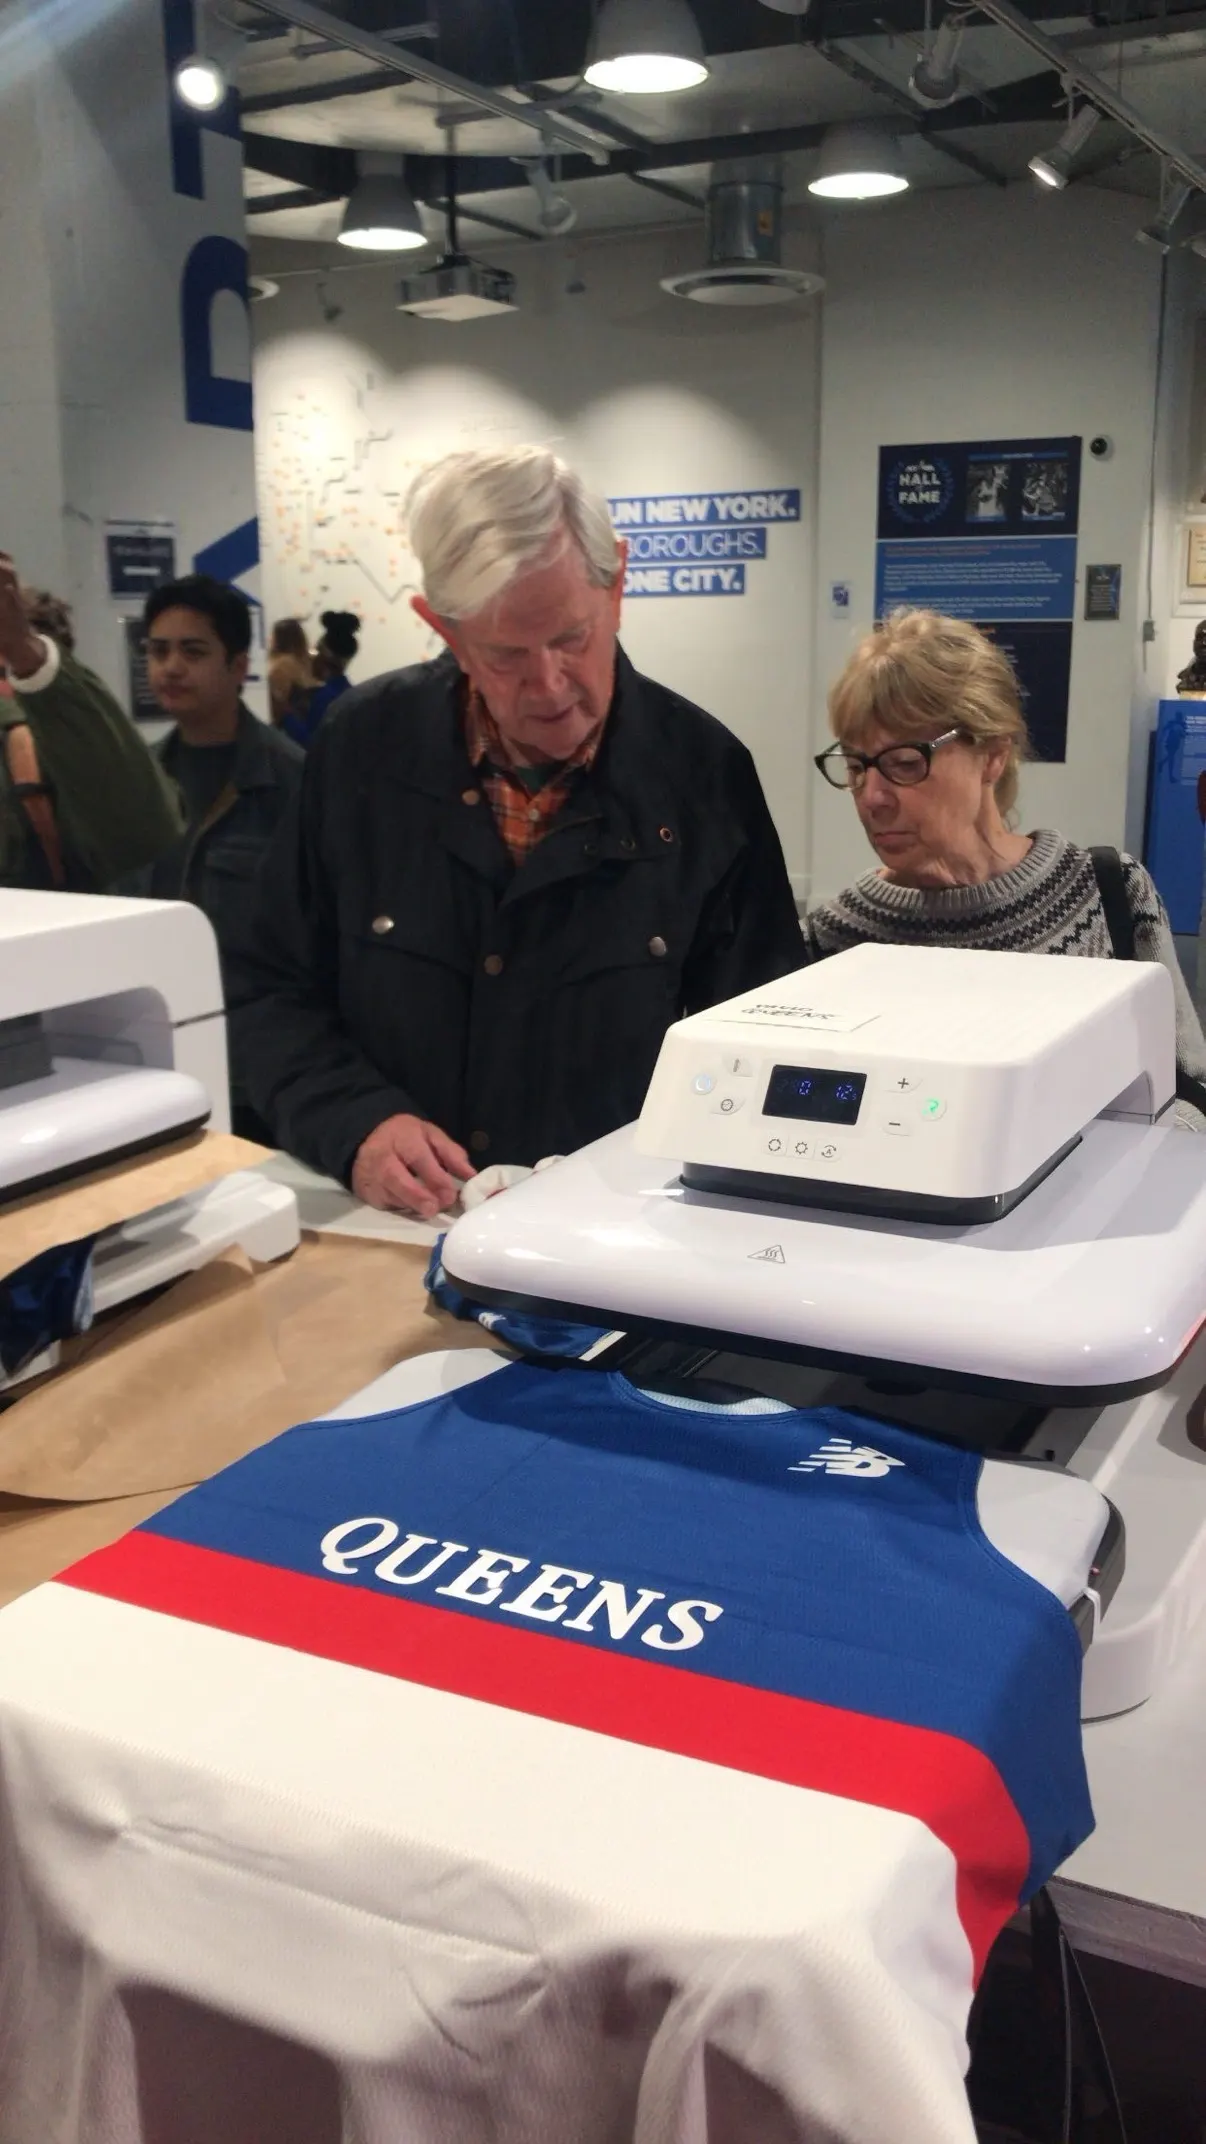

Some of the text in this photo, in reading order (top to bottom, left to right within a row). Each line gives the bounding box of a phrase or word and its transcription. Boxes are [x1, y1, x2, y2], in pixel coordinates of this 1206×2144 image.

[899, 473, 941, 486] HALL
[607, 494, 797, 524] UN NEW YORK.
[899, 491, 940, 504] FAME
[673, 567, 742, 591] CITY.
[320, 1517, 724, 1651] QUEENS
